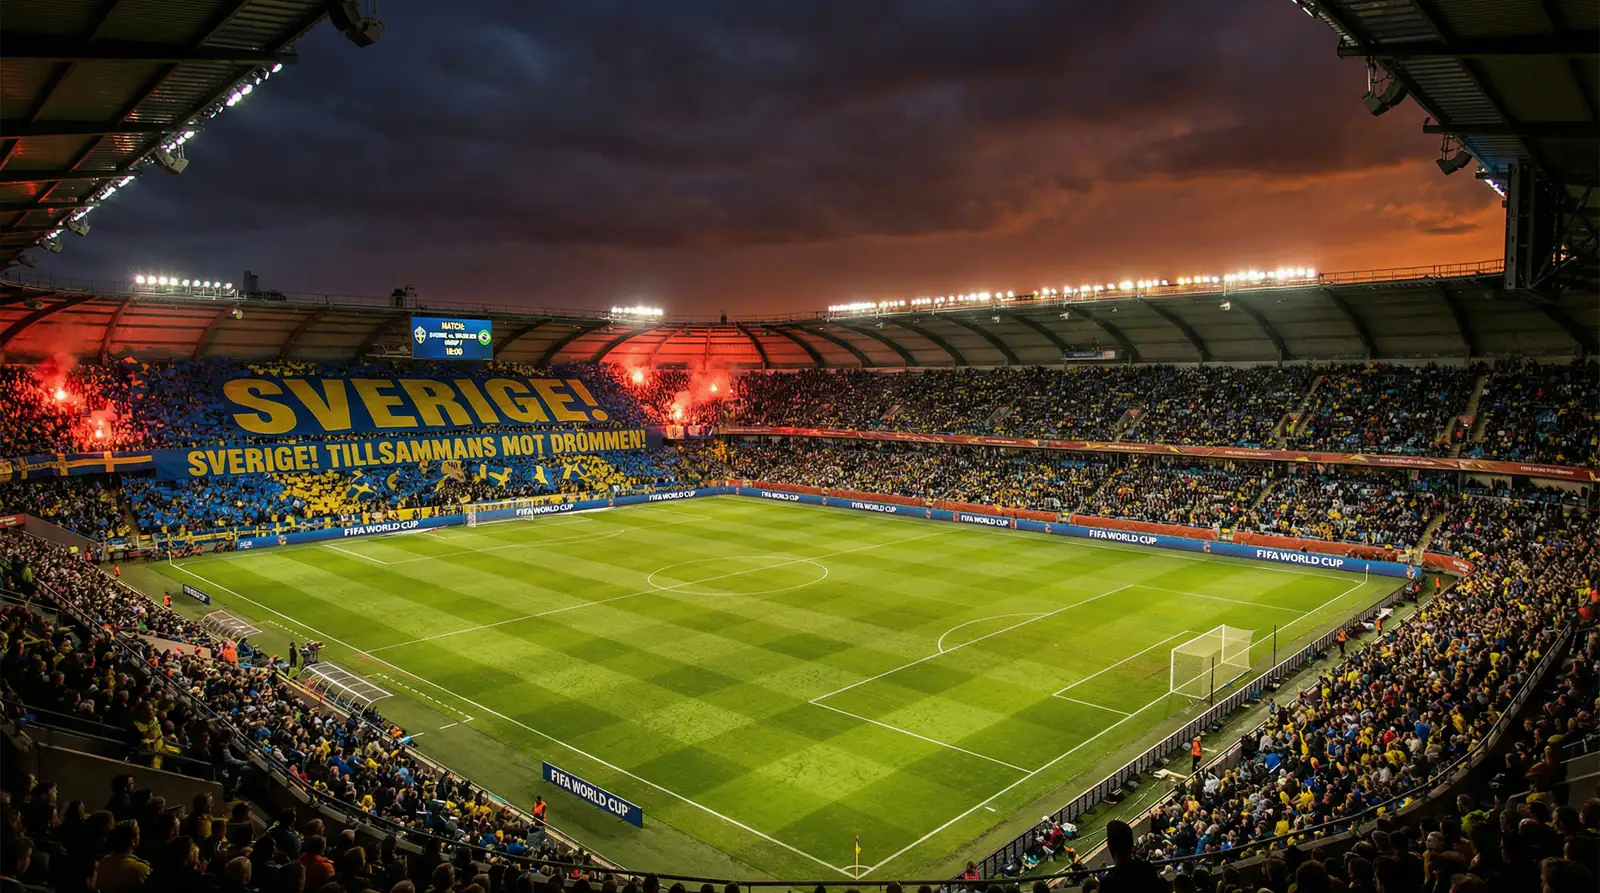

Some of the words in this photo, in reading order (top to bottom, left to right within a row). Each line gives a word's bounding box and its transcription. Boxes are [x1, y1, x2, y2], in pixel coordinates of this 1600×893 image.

[223, 378, 609, 434] SVERIGE!
[187, 445, 319, 476] SVERIGE!
[326, 437, 497, 469] TILLSAMMANS
[501, 433, 545, 456] MOT
[550, 427, 647, 453] DRÖMMEN!
[684, 490, 696, 498] CUP
[533, 505, 559, 514] WORLD
[560, 503, 574, 511] CUP
[864, 503, 884, 512] WORLD
[344, 527, 365, 536] FIFA
[365, 523, 400, 533] WORLD
[401, 520, 419, 529] CUP
[961, 514, 975, 523] FIFA
[975, 515, 996, 526] WORLD
[996, 518, 1009, 527] CUP
[1089, 529, 1107, 539] FIFA
[1107, 531, 1138, 542] WORLD
[1139, 534, 1157, 545] CUP
[1256, 550, 1279, 560] FIFA
[1280, 552, 1320, 565] WORLD
[1321, 557, 1344, 568] CUP
[551, 769, 571, 790] FIFA
[572, 779, 607, 806] WORLD
[608, 798, 628, 817] CUP
